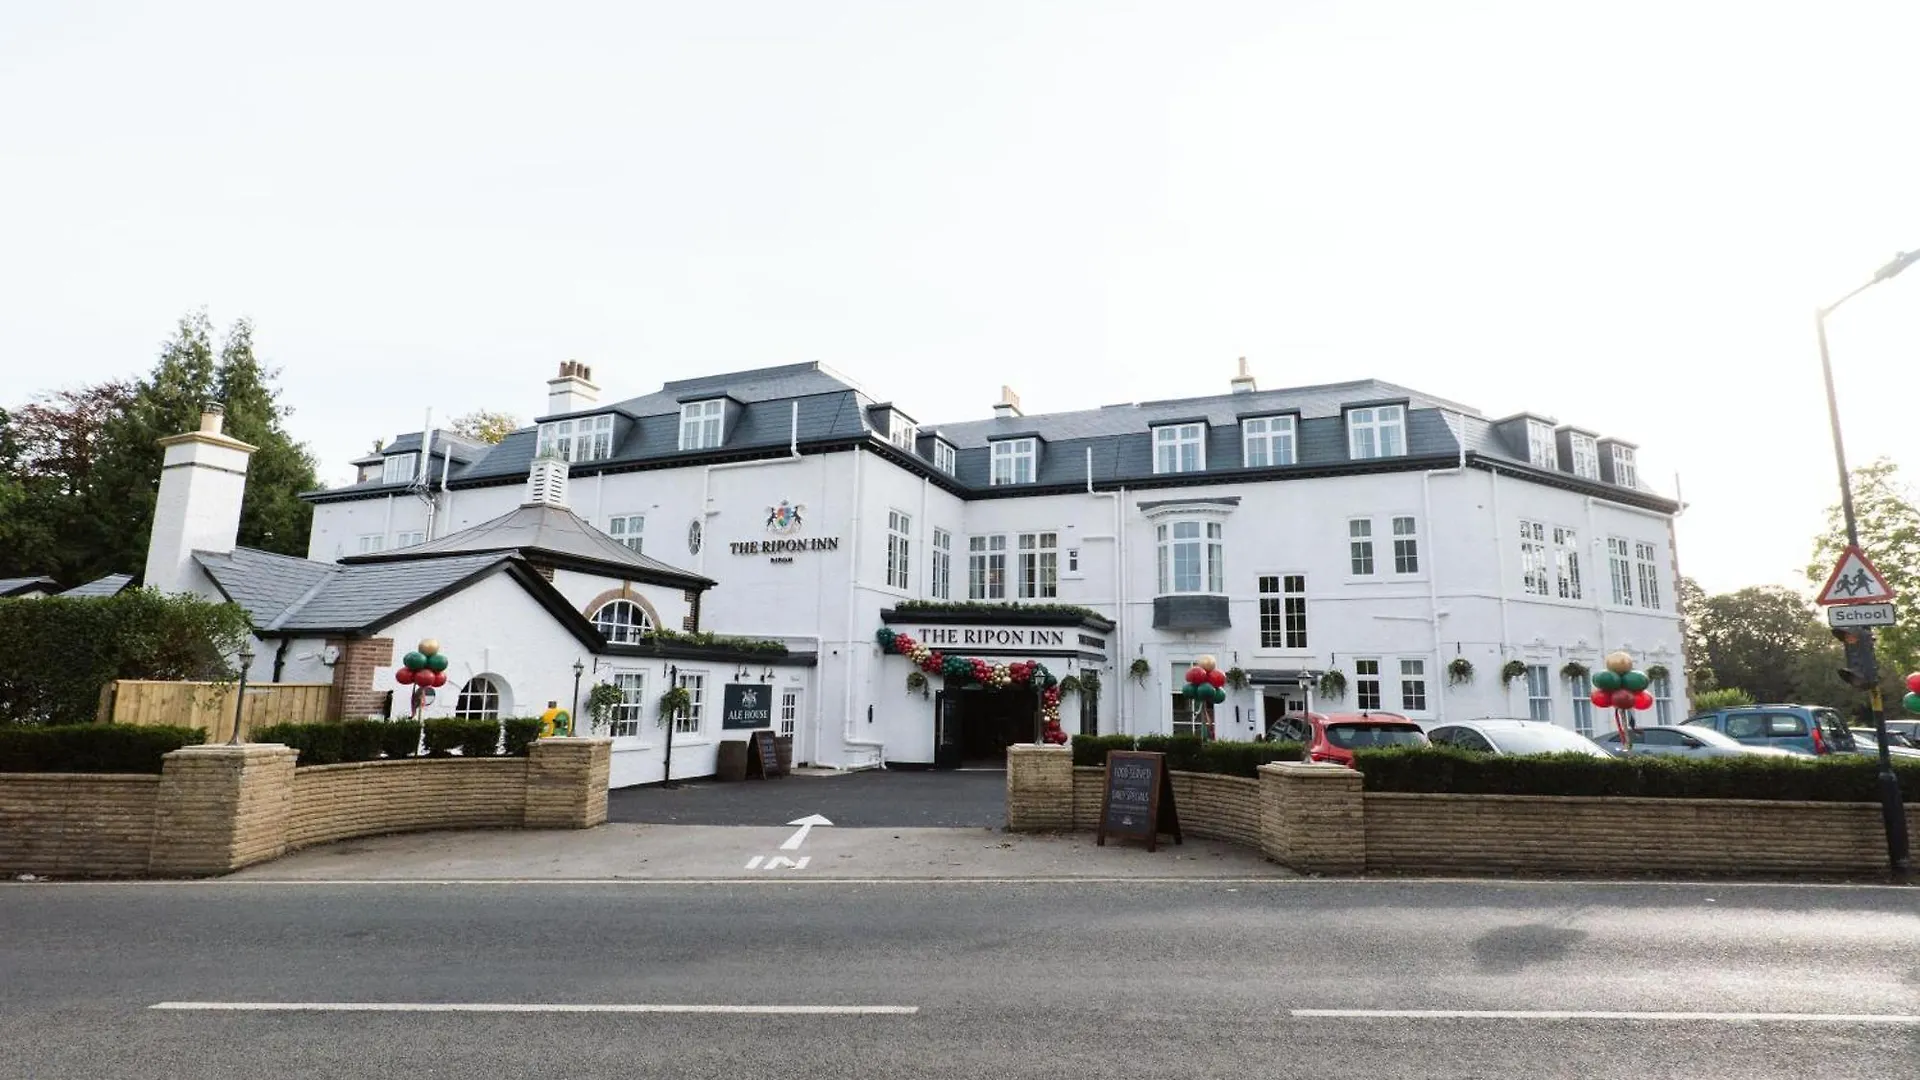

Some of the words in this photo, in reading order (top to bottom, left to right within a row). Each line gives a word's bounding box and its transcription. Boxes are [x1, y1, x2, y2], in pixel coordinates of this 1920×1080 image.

[730, 541, 758, 554] THE
[762, 539, 808, 553] RIPON
[811, 537, 839, 550] INN
[1836, 609, 1887, 621] School
[919, 629, 958, 643] THE
[964, 630, 1024, 645] RIPON
[1031, 631, 1064, 645] INN
[728, 710, 743, 720] ALE
[745, 709, 768, 720] HOUSE
[744, 855, 812, 869] IN
